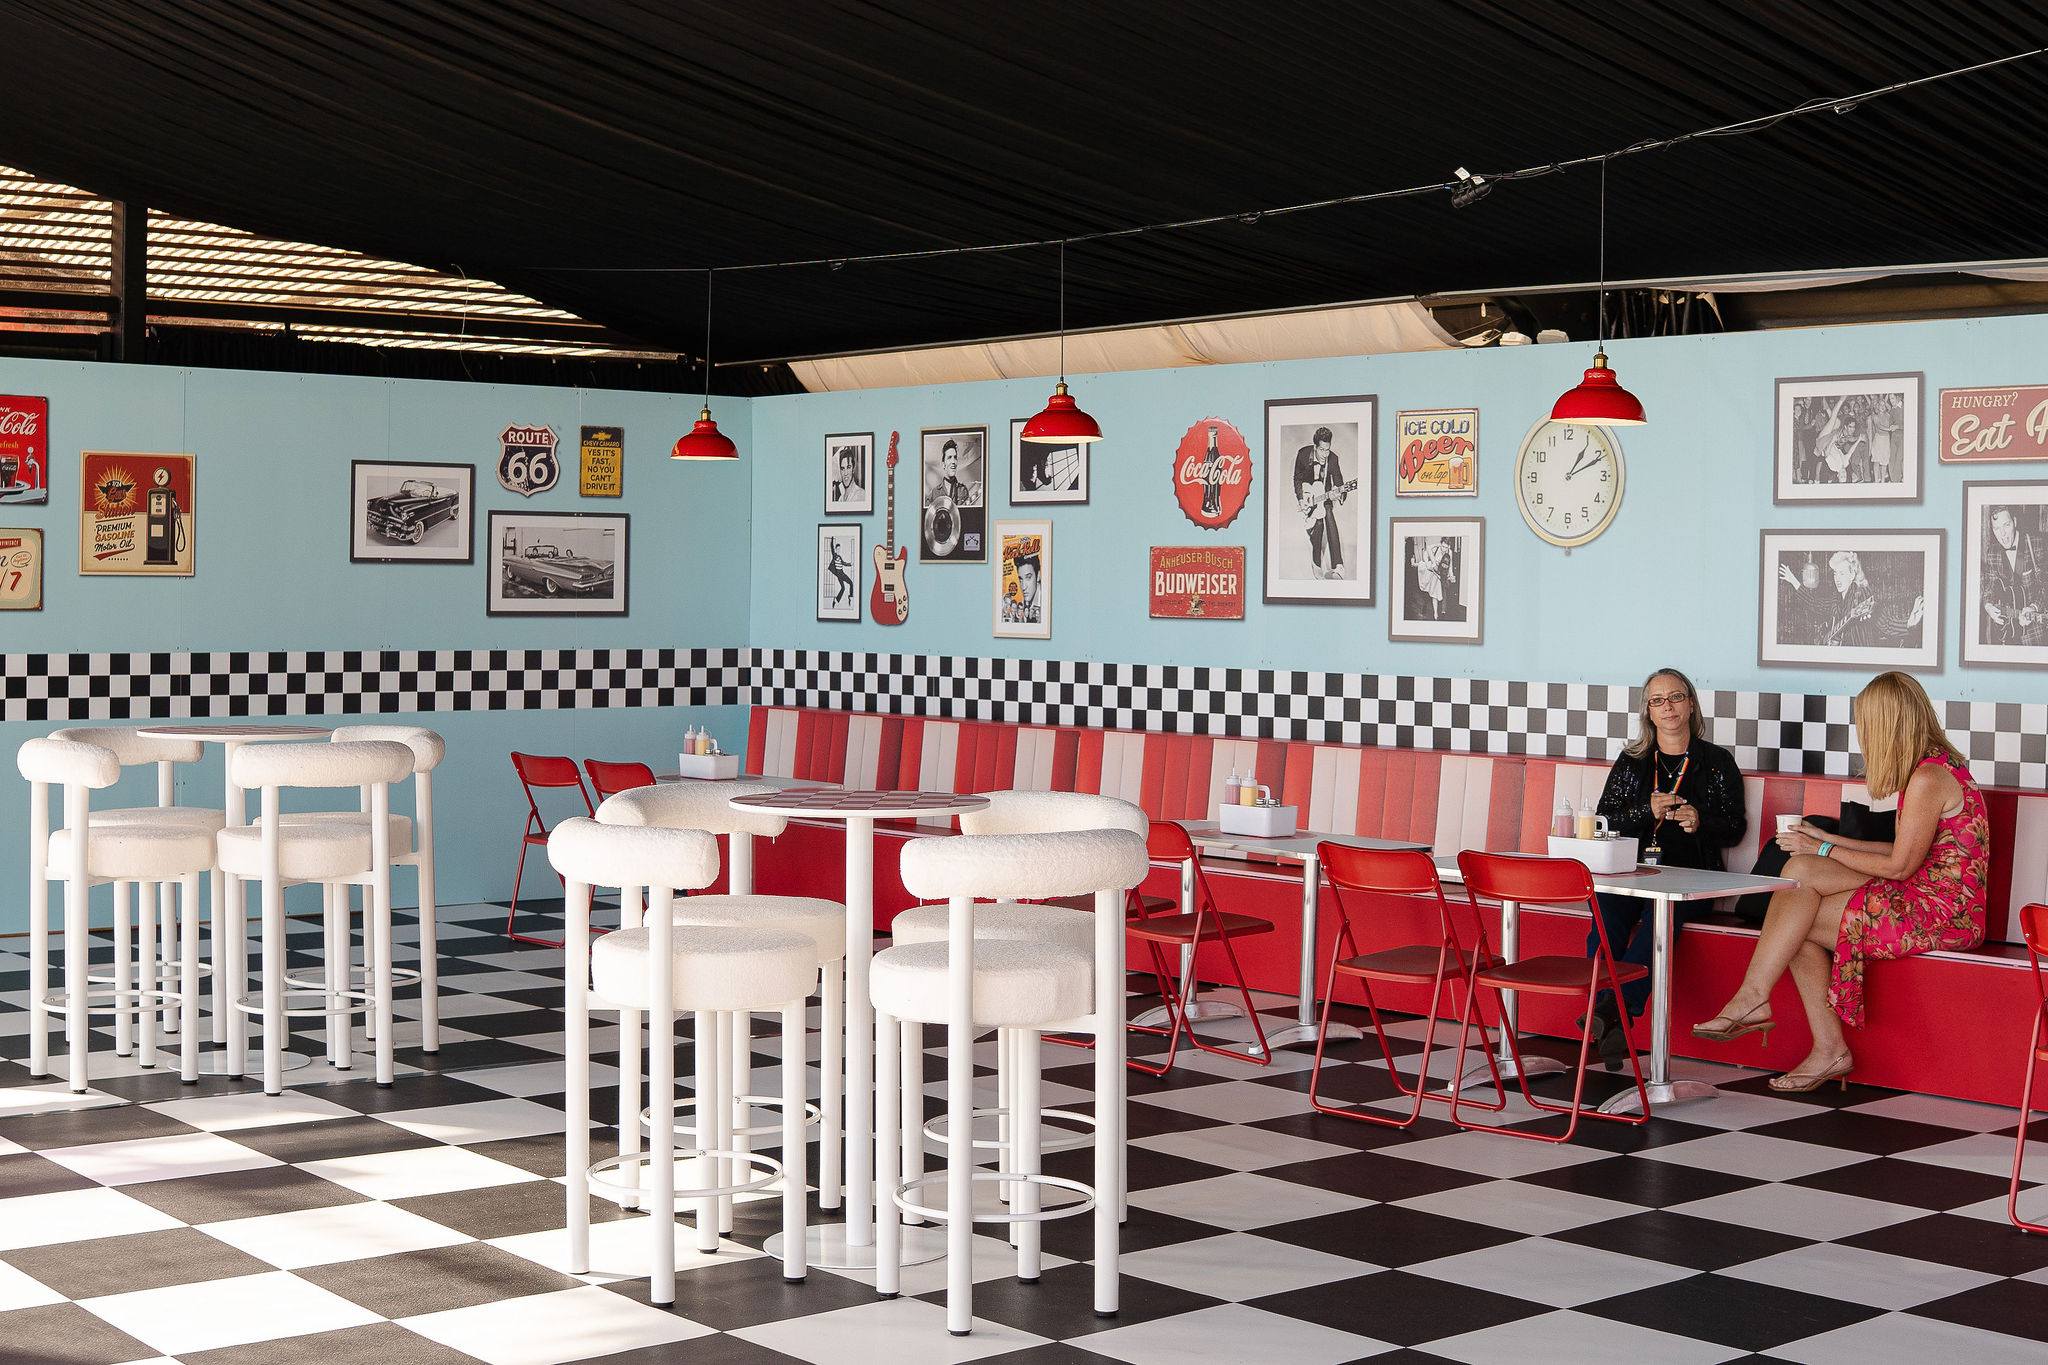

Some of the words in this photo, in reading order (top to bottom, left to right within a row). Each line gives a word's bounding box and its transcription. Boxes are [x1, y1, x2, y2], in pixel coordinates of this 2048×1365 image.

[1951, 391, 2019, 409] HUNGRY?
[1404, 419, 1427, 435] ICE
[1431, 418, 1470, 434] COLD
[508, 431, 549, 444] ROUTE
[1563, 429, 1573, 440] 12
[1951, 413, 2016, 456] Eat
[1548, 436, 1556, 447] 11
[587, 449, 601, 457] YES
[602, 449, 616, 457] IT'S
[1536, 451, 1546, 462] 10
[1595, 450, 1602, 461] 2
[591, 457, 611, 465] FAST,
[1400, 436, 1474, 483] Beer
[508, 452, 549, 484] 66
[587, 466, 599, 474] NO
[599, 466, 615, 474] YOU
[1180, 455, 1244, 485] Coca-Cola
[1421, 471, 1434, 479] on
[1433, 463, 1448, 486] Tap
[1530, 472, 1537, 483] 9
[1600, 471, 1607, 482] 3
[1536, 493, 1543, 504] 8
[1594, 492, 1600, 503] 4
[1548, 507, 1554, 518] 7
[1581, 507, 1588, 518] 5
[1564, 513, 1571, 524] 6
[95, 522, 132, 534] PREMIUM
[95, 530, 135, 542] GASOLINE
[95, 543, 118, 552] Motor
[119, 539, 132, 549] Oil
[1160, 551, 1233, 569] ANHEUSER-BUSCH
[1155, 571, 1237, 596] BUDWEISER
